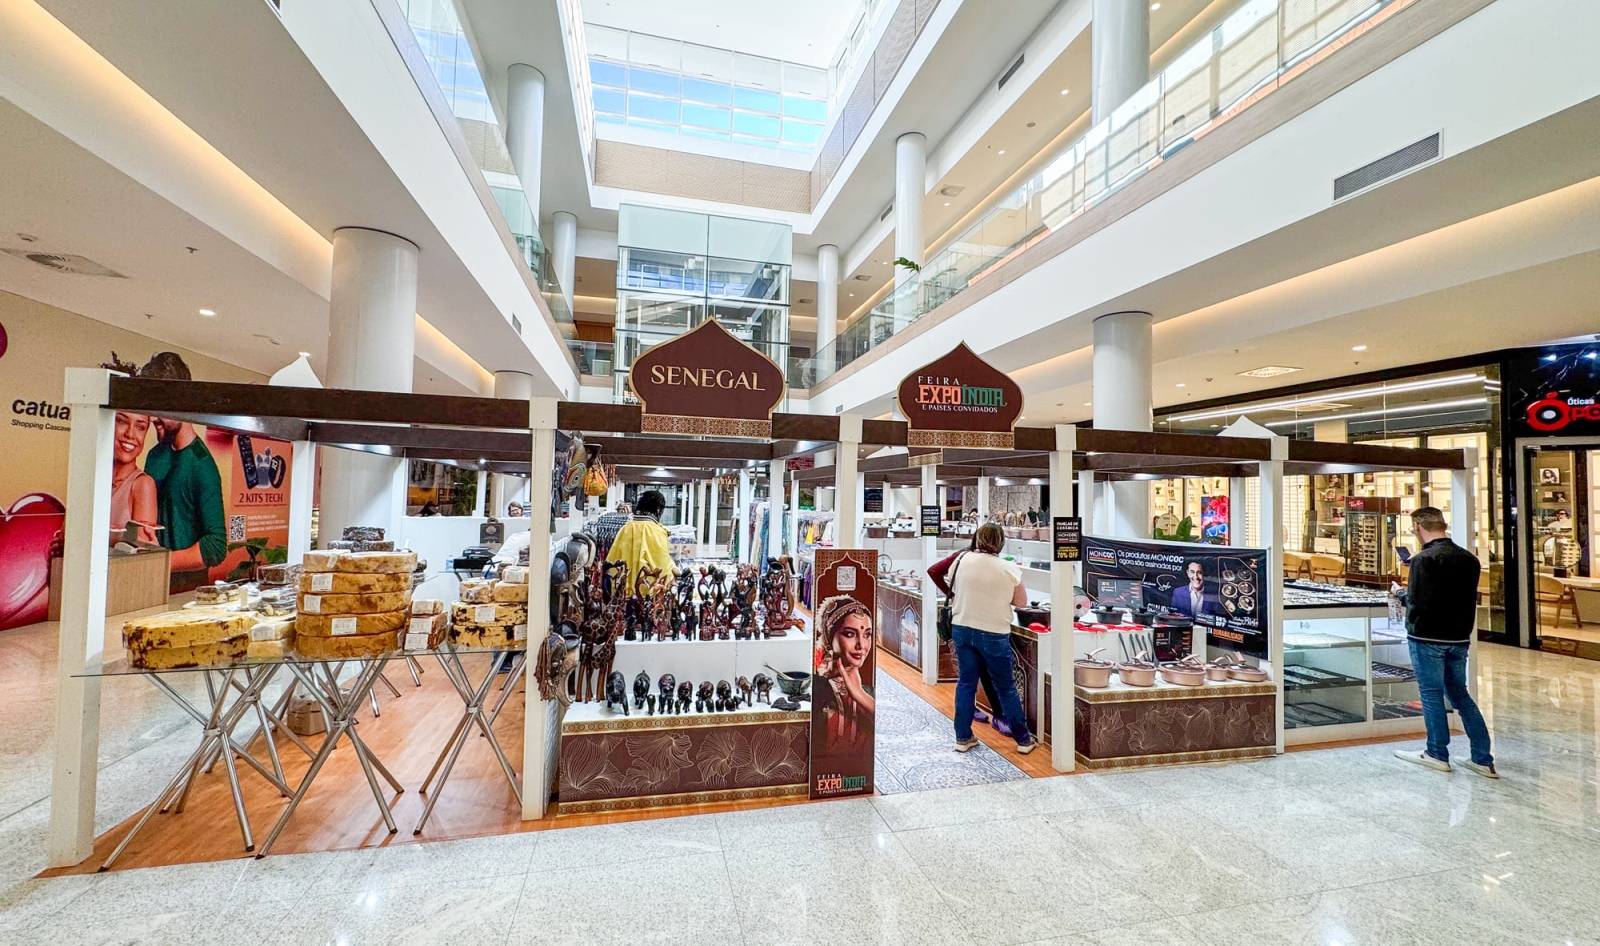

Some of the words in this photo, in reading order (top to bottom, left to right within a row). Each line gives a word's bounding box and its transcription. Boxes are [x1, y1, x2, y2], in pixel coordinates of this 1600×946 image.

[651, 364, 766, 391] SENEGAL
[918, 376, 960, 385] FEIRA
[1567, 397, 1595, 406] Óticas
[12, 399, 71, 421] catua
[953, 405, 999, 413] CONVIDADOS
[11, 419, 44, 430] Shopping
[45, 423, 71, 432] Cascave
[239, 493, 245, 503] 2
[246, 493, 263, 503] KITS
[265, 493, 283, 503] TECH
[1089, 550, 1115, 559] MONCOC
[1117, 549, 1125, 557] Os
[1126, 551, 1150, 560] produtos
[1151, 554, 1185, 563] MONCOC
[1119, 558, 1135, 566] agora
[1145, 562, 1171, 570] assinados
